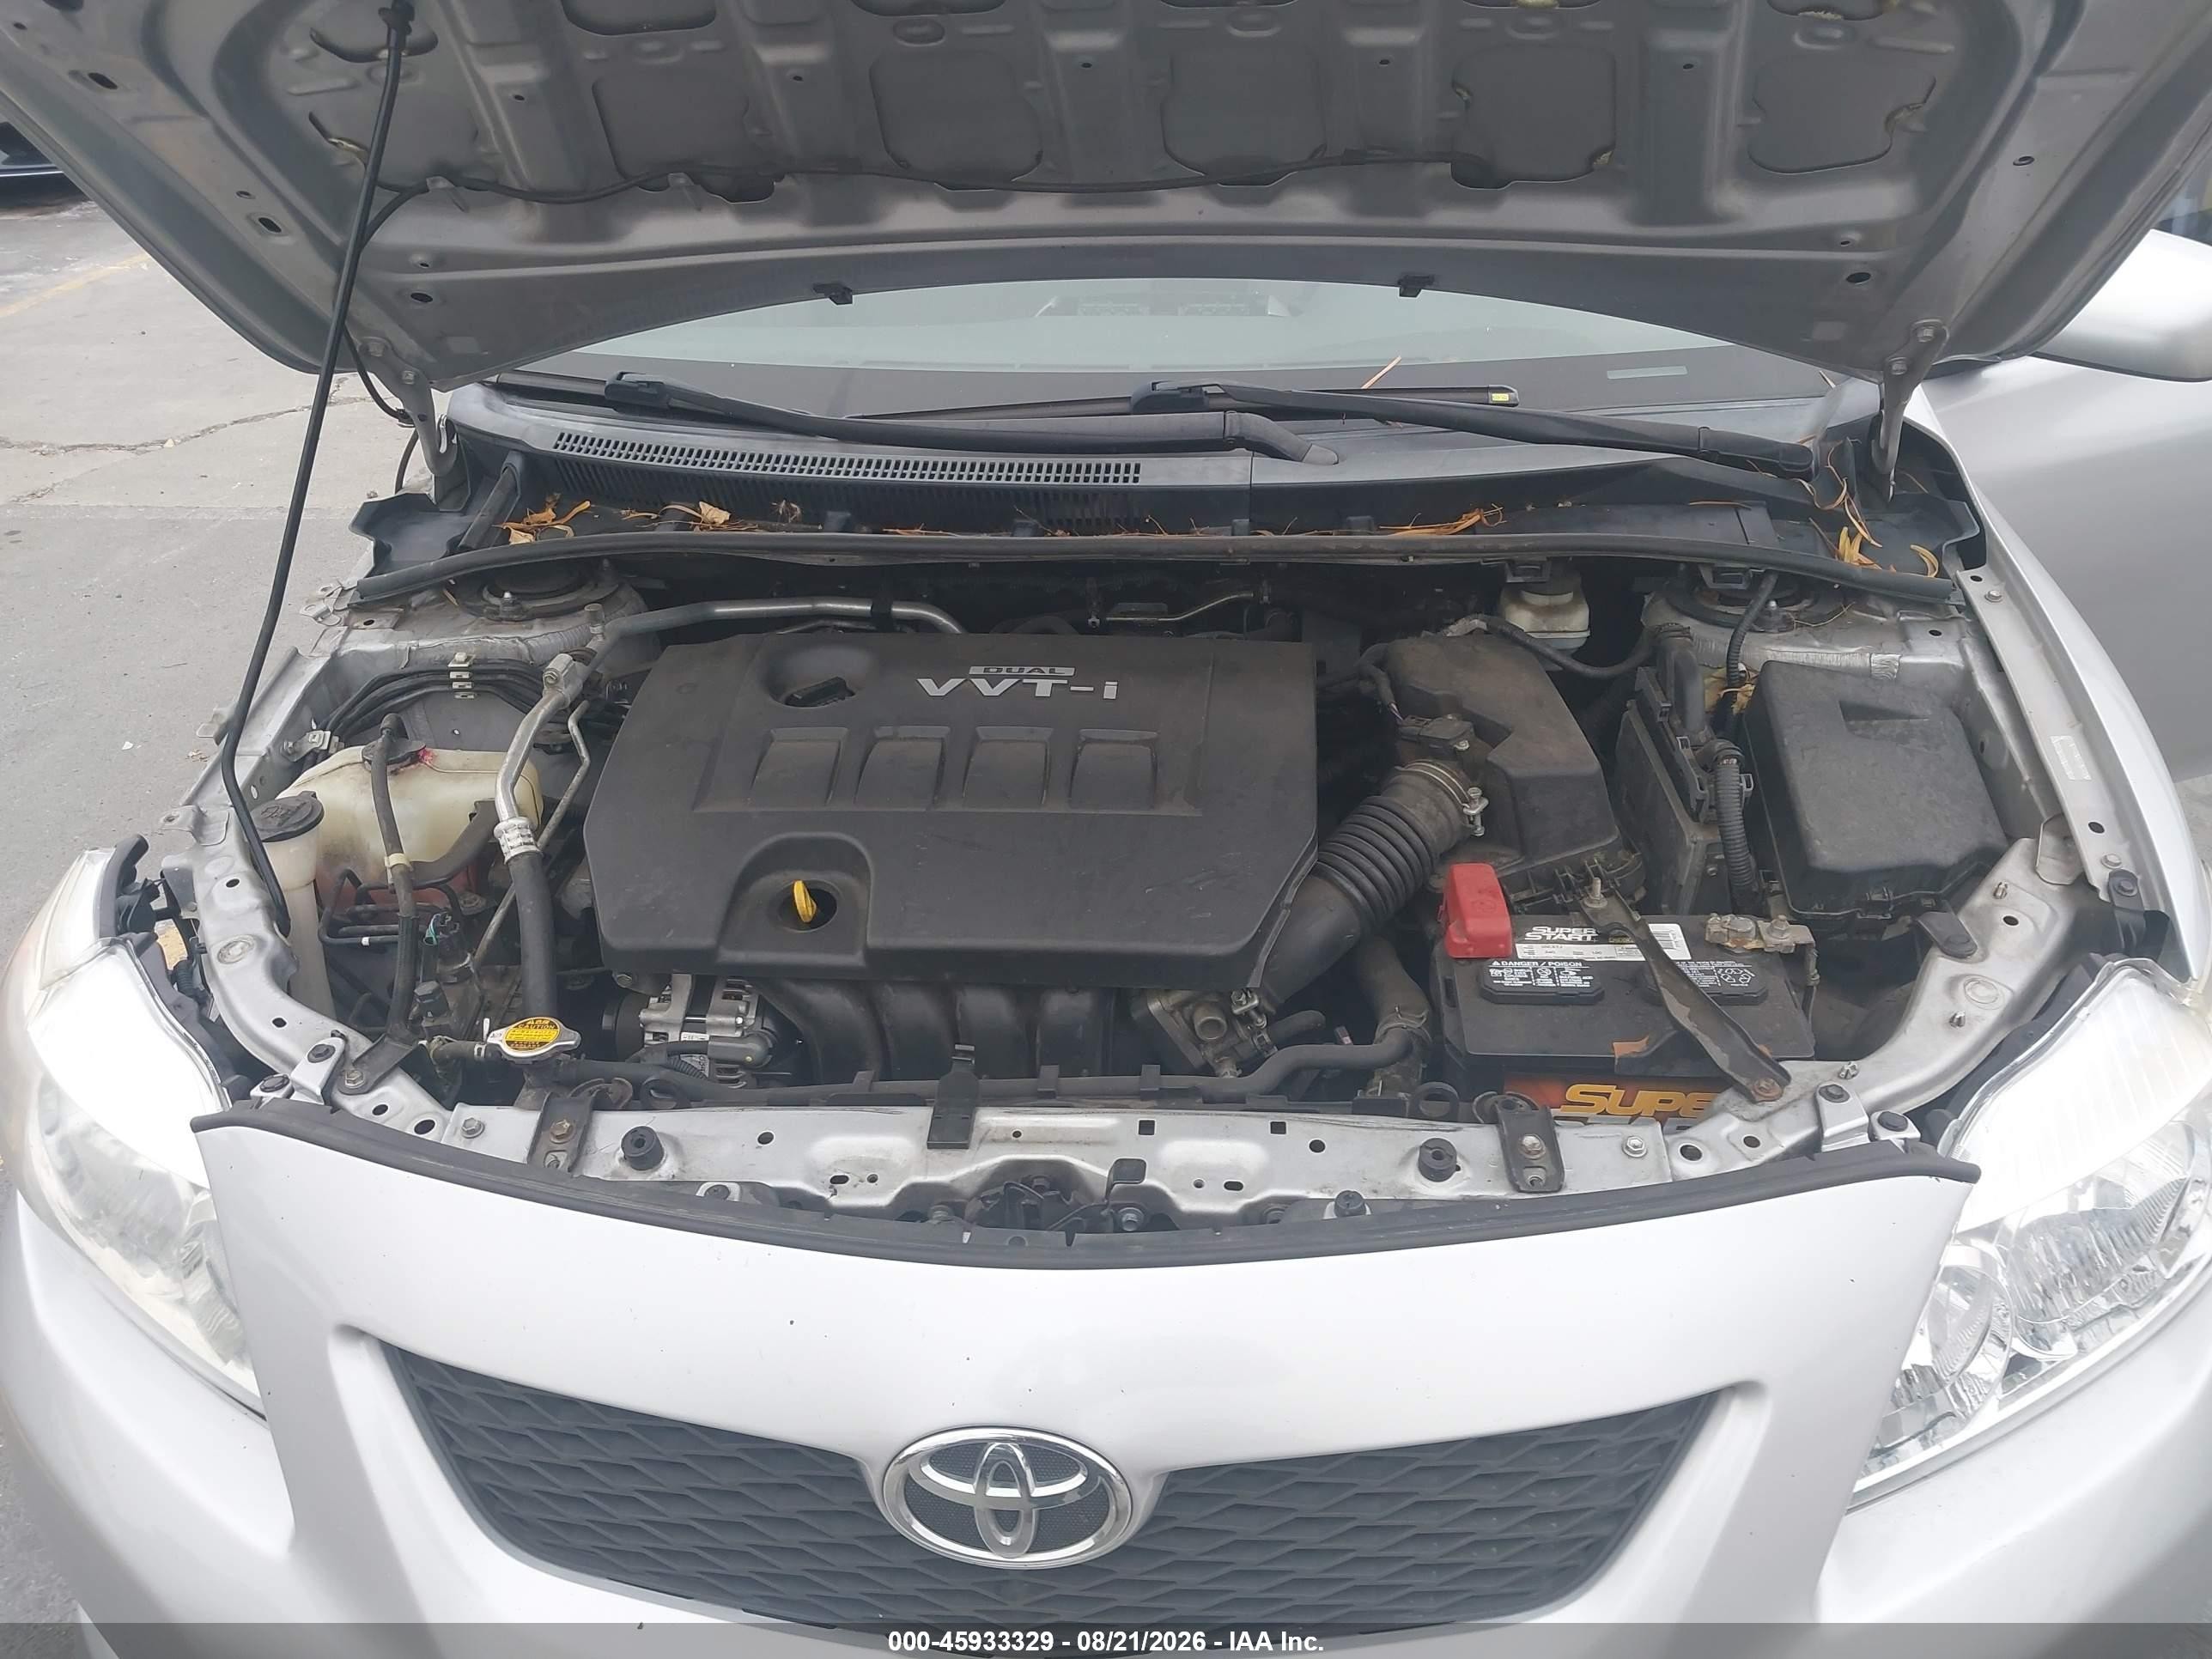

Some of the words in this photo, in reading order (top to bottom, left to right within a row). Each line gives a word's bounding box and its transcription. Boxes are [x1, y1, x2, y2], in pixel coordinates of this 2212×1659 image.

[981, 666, 1067, 675] DUAL
[916, 678, 1118, 700] VVT-i
[1531, 926, 1596, 934] SUPER
[1524, 932, 1598, 942] START
[1559, 1084, 1720, 1118] SUPE
